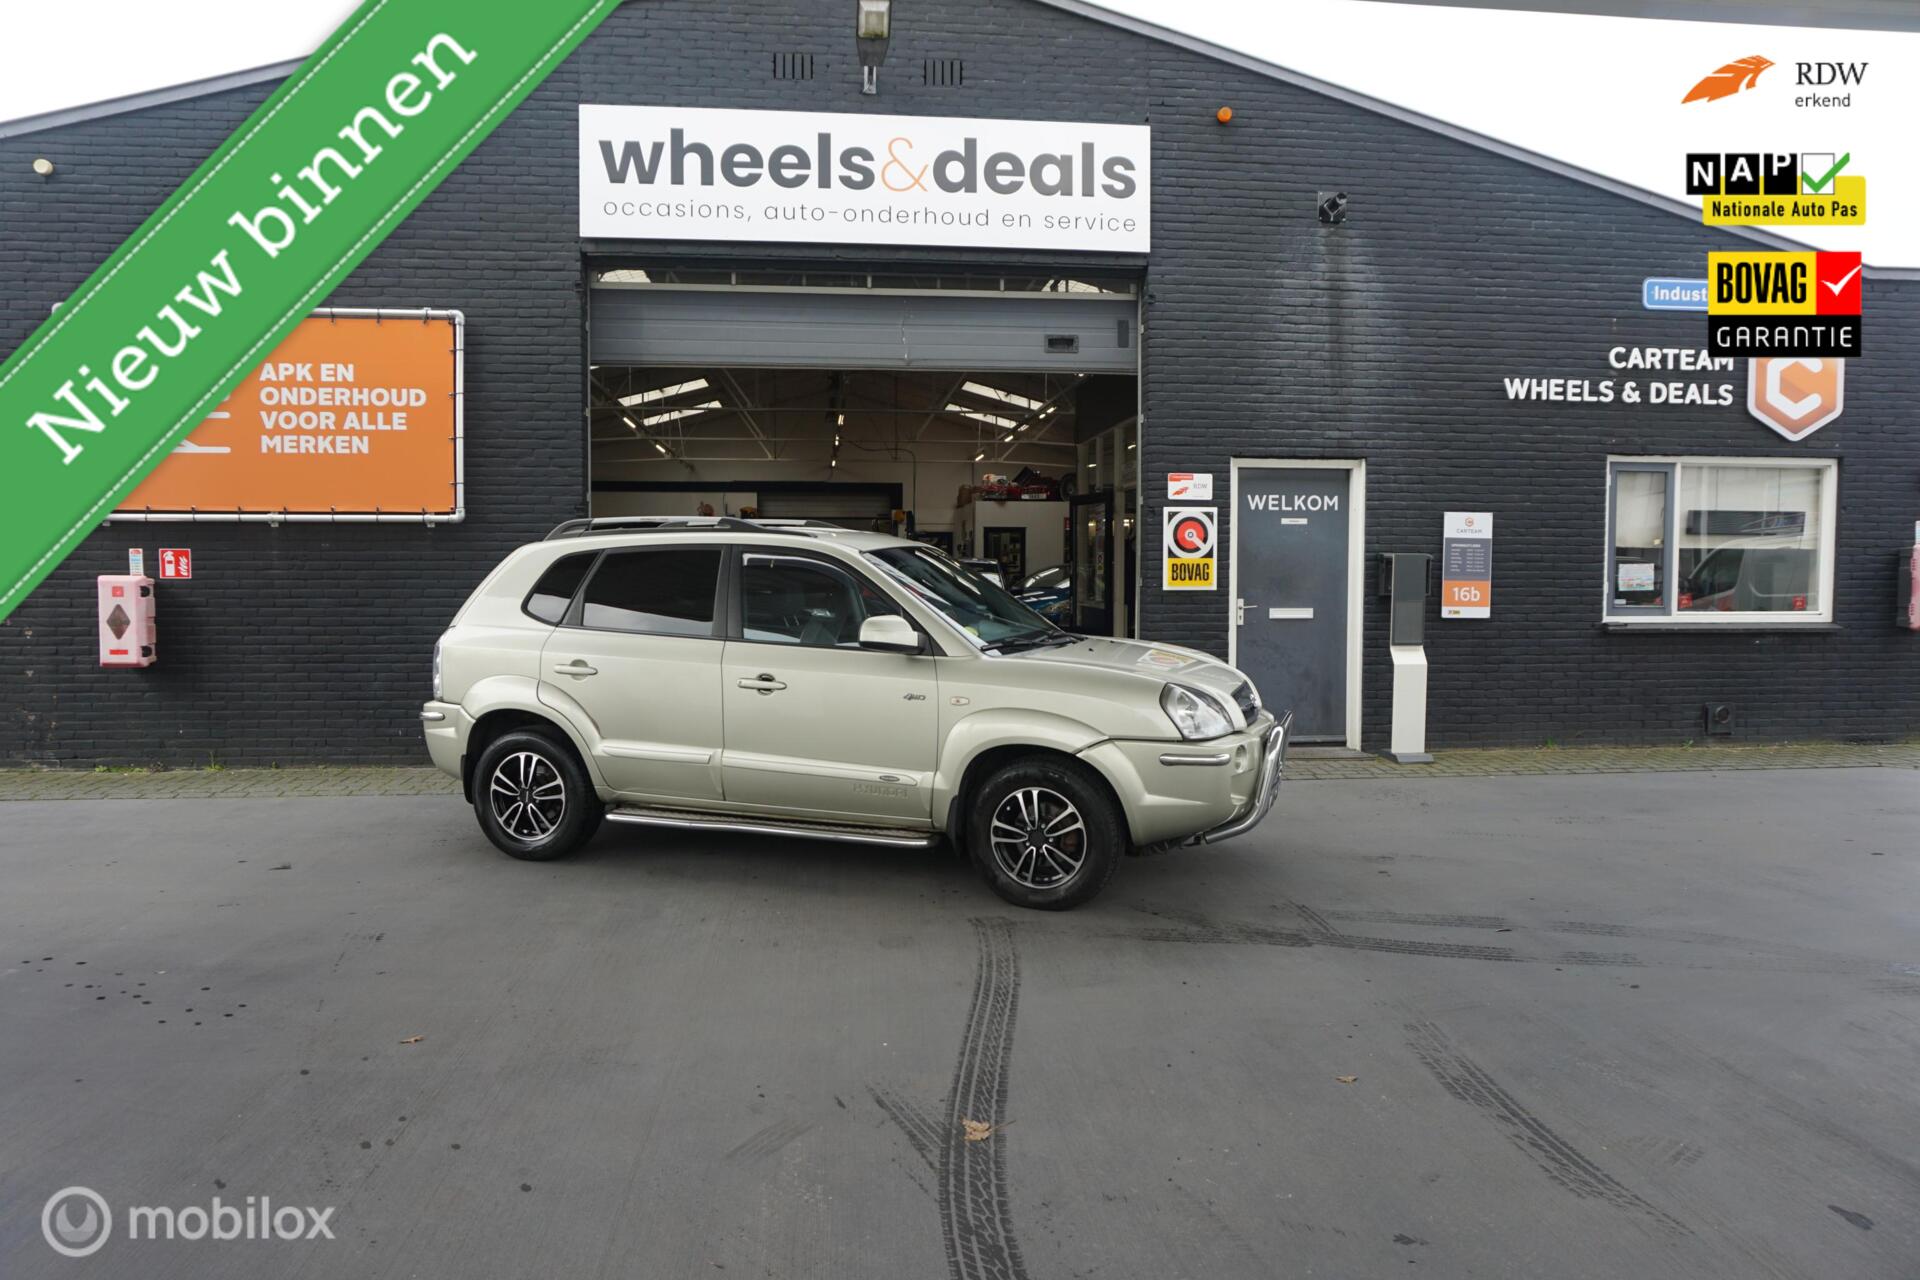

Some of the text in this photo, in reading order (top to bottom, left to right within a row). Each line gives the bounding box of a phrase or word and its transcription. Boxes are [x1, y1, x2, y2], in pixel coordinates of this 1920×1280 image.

[603, 199, 1136, 232] occasions, auto-onderhoud en service
[1654, 285, 1708, 302] Indust
[1609, 346, 1734, 371] CARTEAM
[259, 363, 354, 382] APK EN
[259, 387, 427, 407] ONDERHOUD
[1504, 377, 1734, 406] WHEELS & DEALS
[259, 411, 408, 431] VOOR ALLE
[260, 435, 370, 454] MERKEN
[1247, 494, 1339, 511] WELKOM
[1171, 563, 1210, 582] BOVAG
[1452, 586, 1481, 602] 16b
